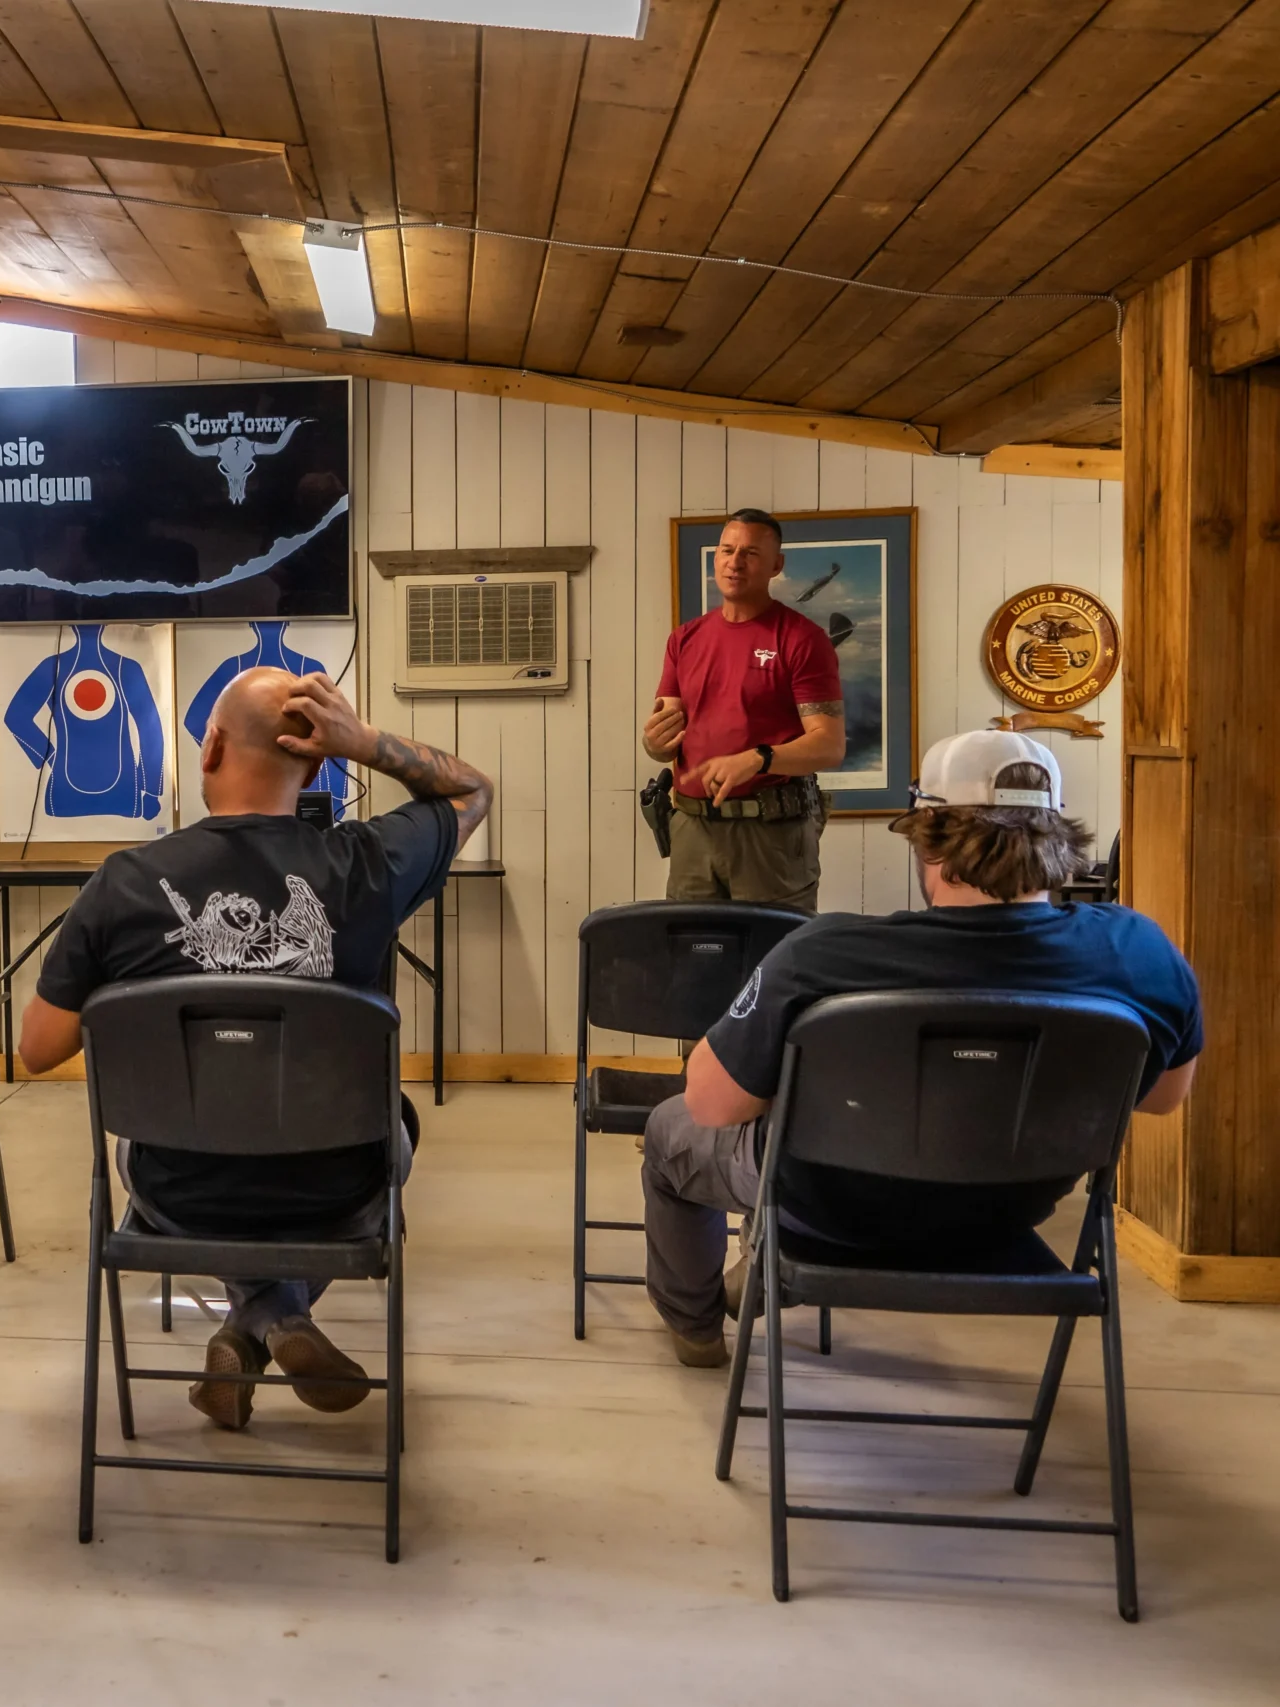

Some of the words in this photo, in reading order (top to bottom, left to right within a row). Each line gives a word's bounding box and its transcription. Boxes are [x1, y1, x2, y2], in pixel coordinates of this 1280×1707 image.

[1010, 591, 1056, 616] UNITED
[1060, 591, 1104, 622] STATES
[999, 671, 1047, 705] MARINE
[1054, 677, 1100, 705] CORPS
